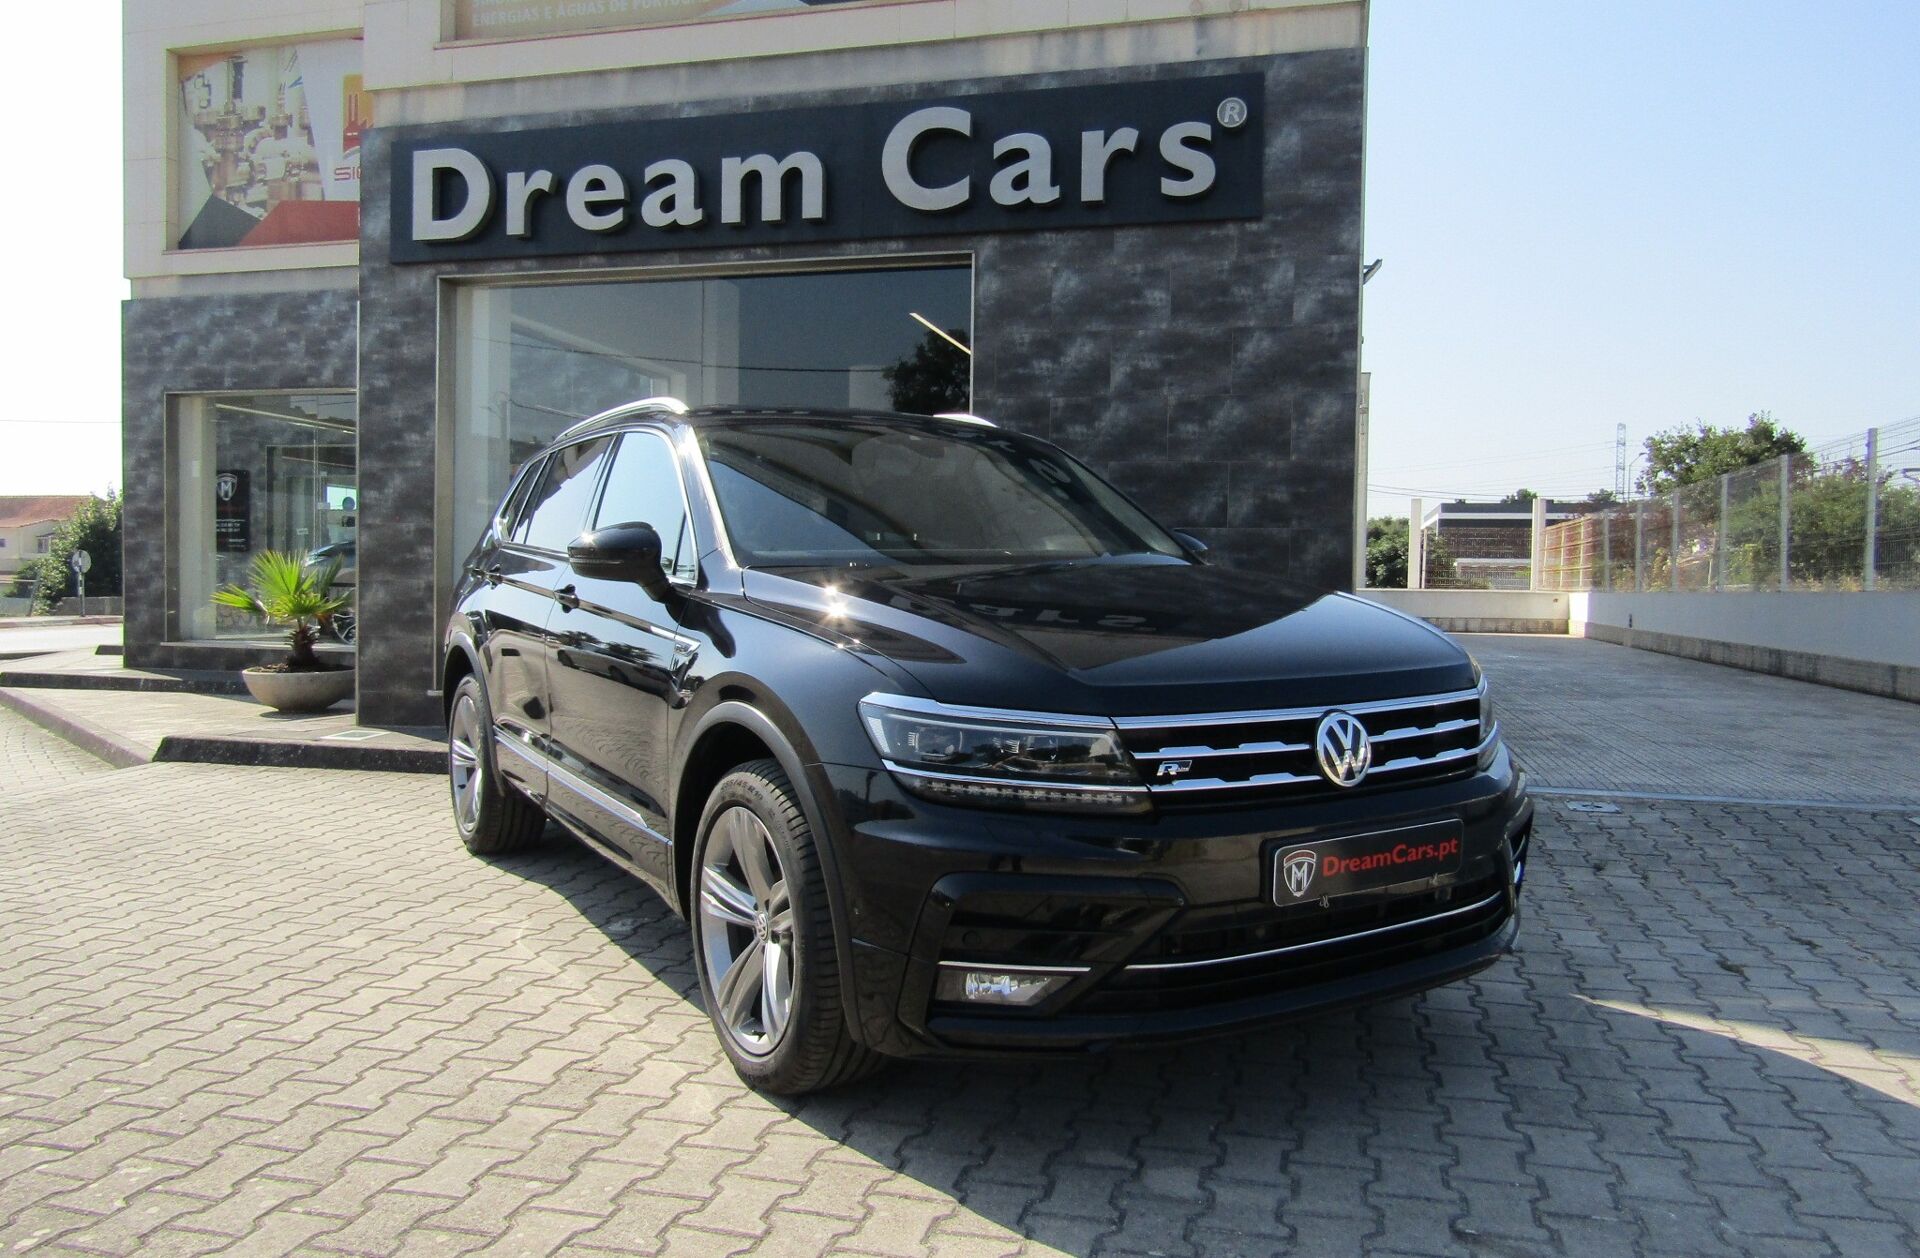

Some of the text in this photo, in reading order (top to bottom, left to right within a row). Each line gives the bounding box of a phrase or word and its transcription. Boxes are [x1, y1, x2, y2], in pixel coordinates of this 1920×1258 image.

[472, 6, 540, 27] ENERGIAS
[543, 5, 553, 20] E
[412, 147, 828, 242] Dream
[881, 105, 1217, 211] Cars
[1322, 837, 1458, 877] DreamCars.pt
